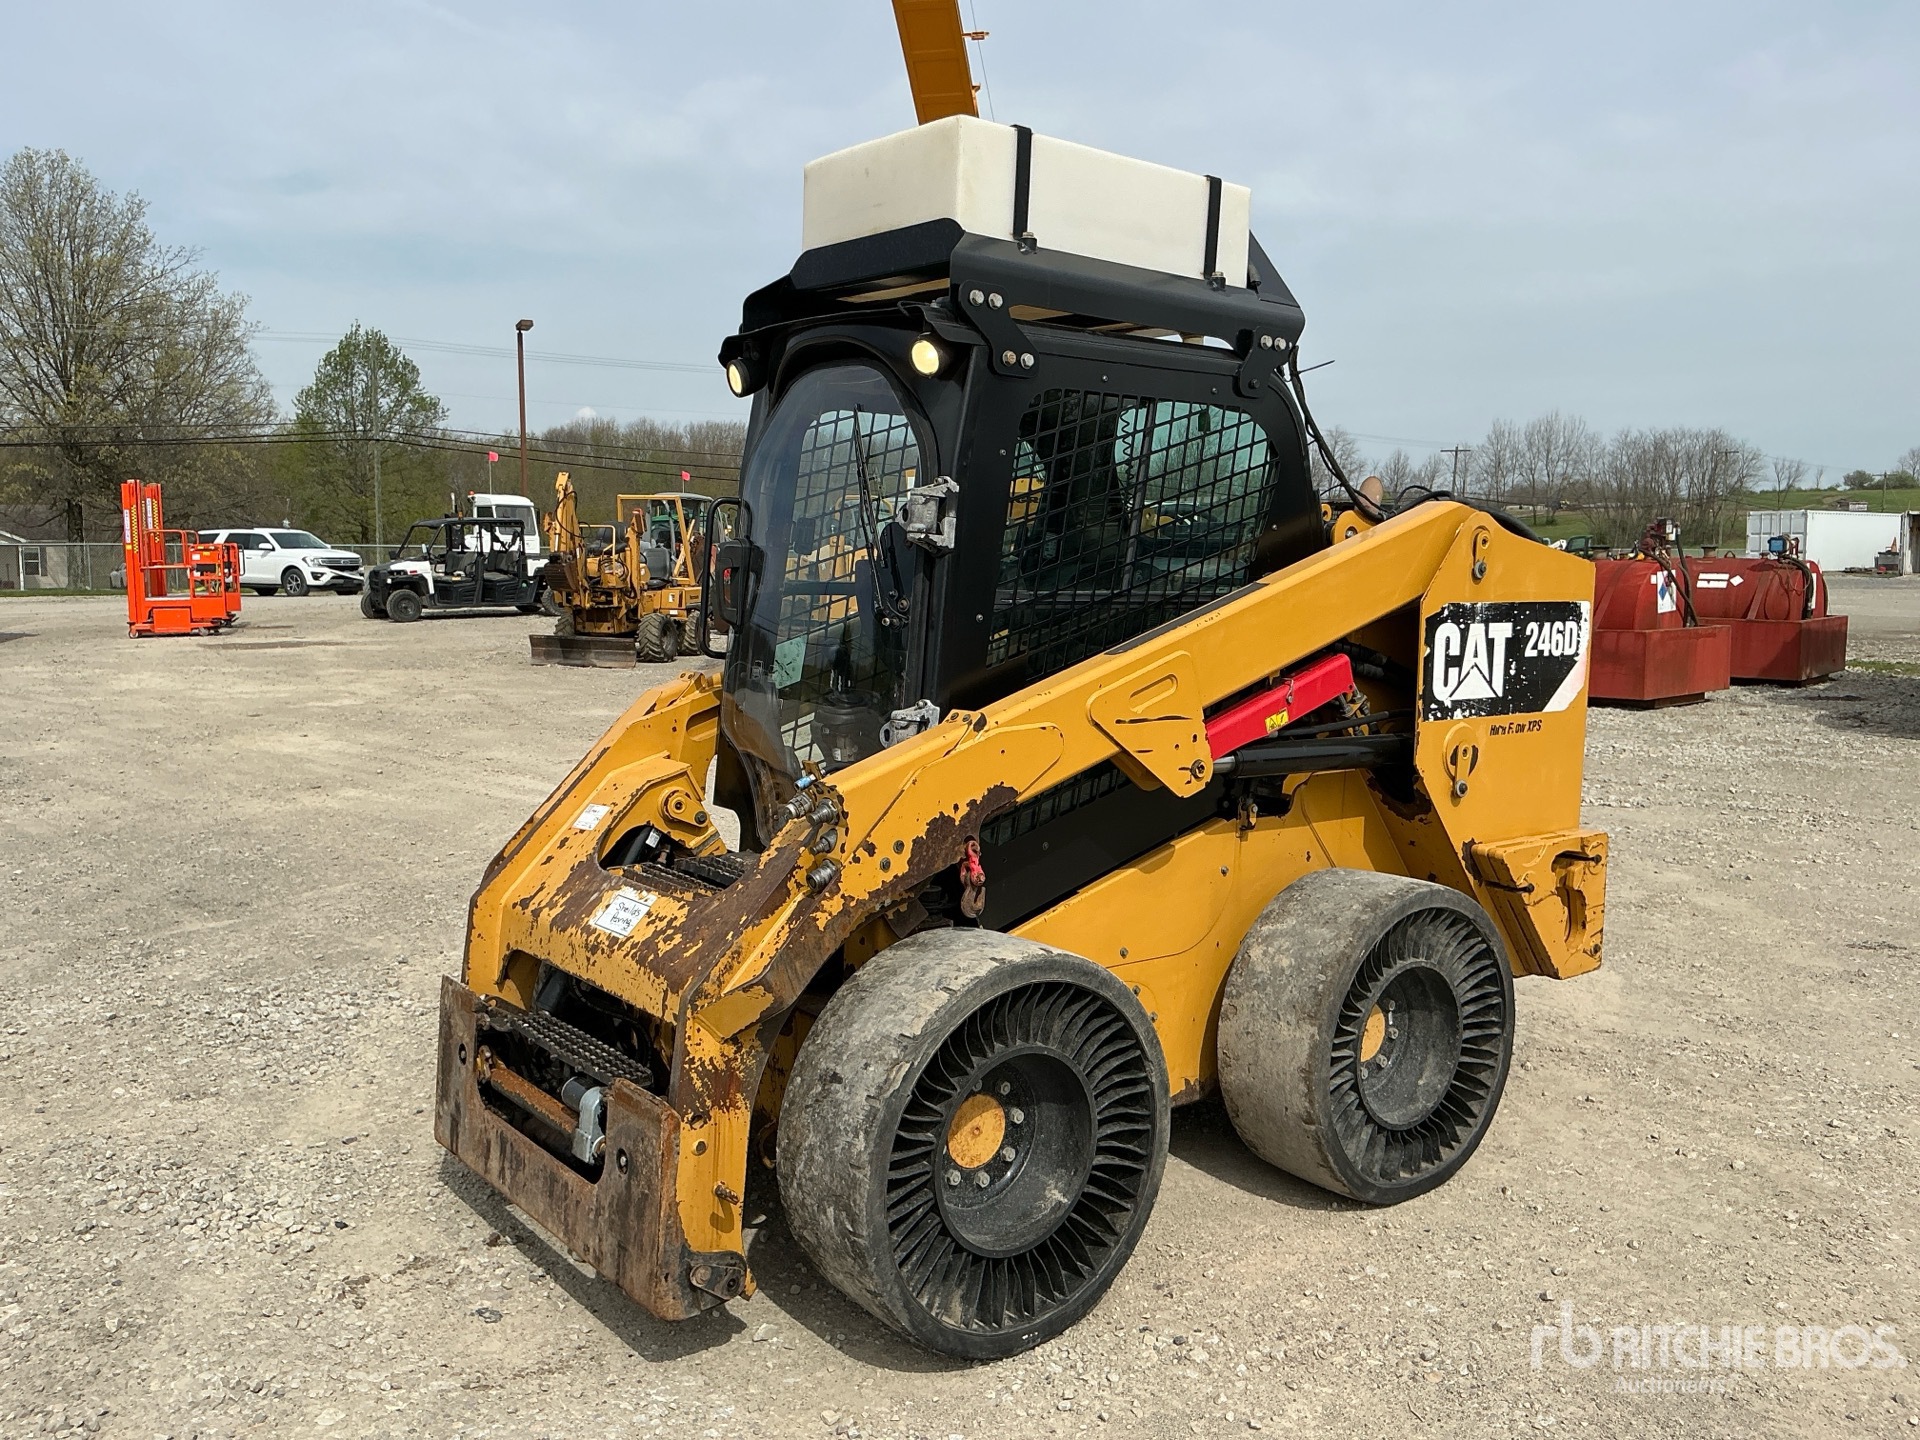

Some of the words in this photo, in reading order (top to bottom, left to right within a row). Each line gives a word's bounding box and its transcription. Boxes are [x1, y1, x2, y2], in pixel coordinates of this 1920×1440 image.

[1432, 622, 1513, 701] CAT
[1524, 621, 1578, 658] 246D
[1527, 719, 1542, 732] XPS
